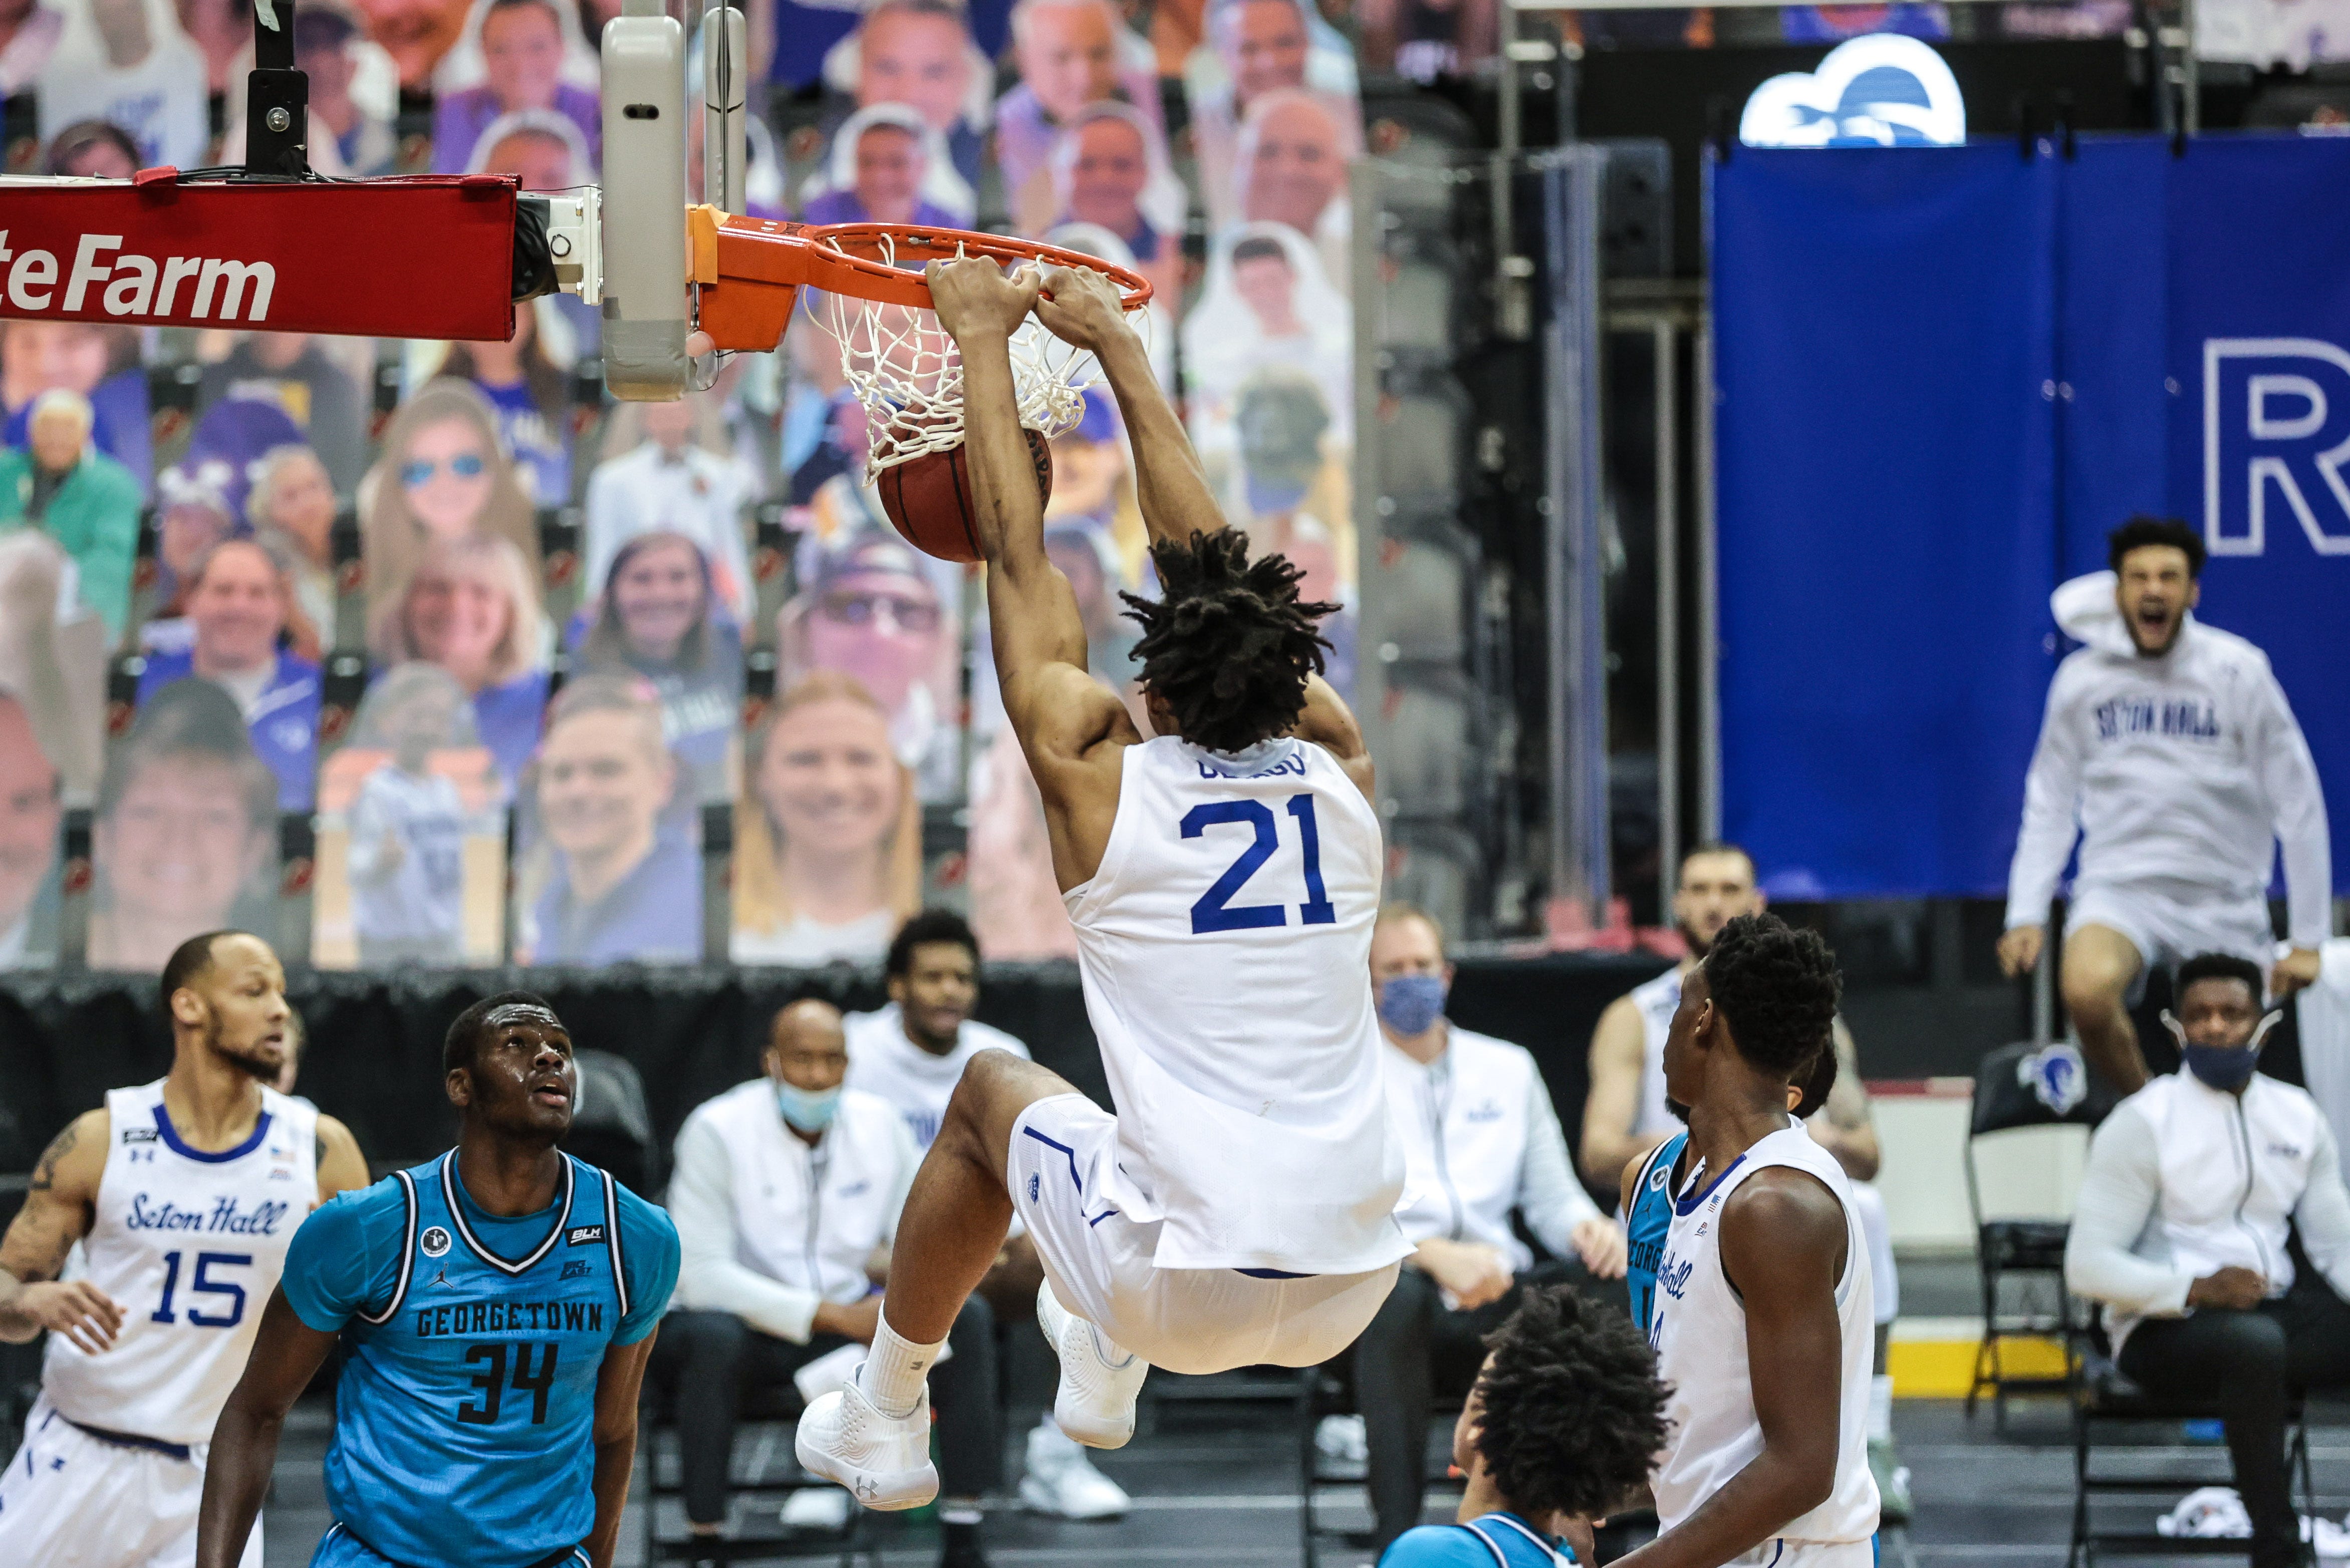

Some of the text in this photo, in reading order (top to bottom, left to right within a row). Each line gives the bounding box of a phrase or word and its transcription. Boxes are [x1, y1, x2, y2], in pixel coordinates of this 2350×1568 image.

[1179, 793, 1337, 934] 21
[127, 1191, 289, 1234] Seton Hall
[571, 1228, 601, 1240] BLM
[151, 1251, 252, 1328] 15
[417, 1301, 603, 1338] GEORGETOWN
[457, 1343, 559, 1425] 34
